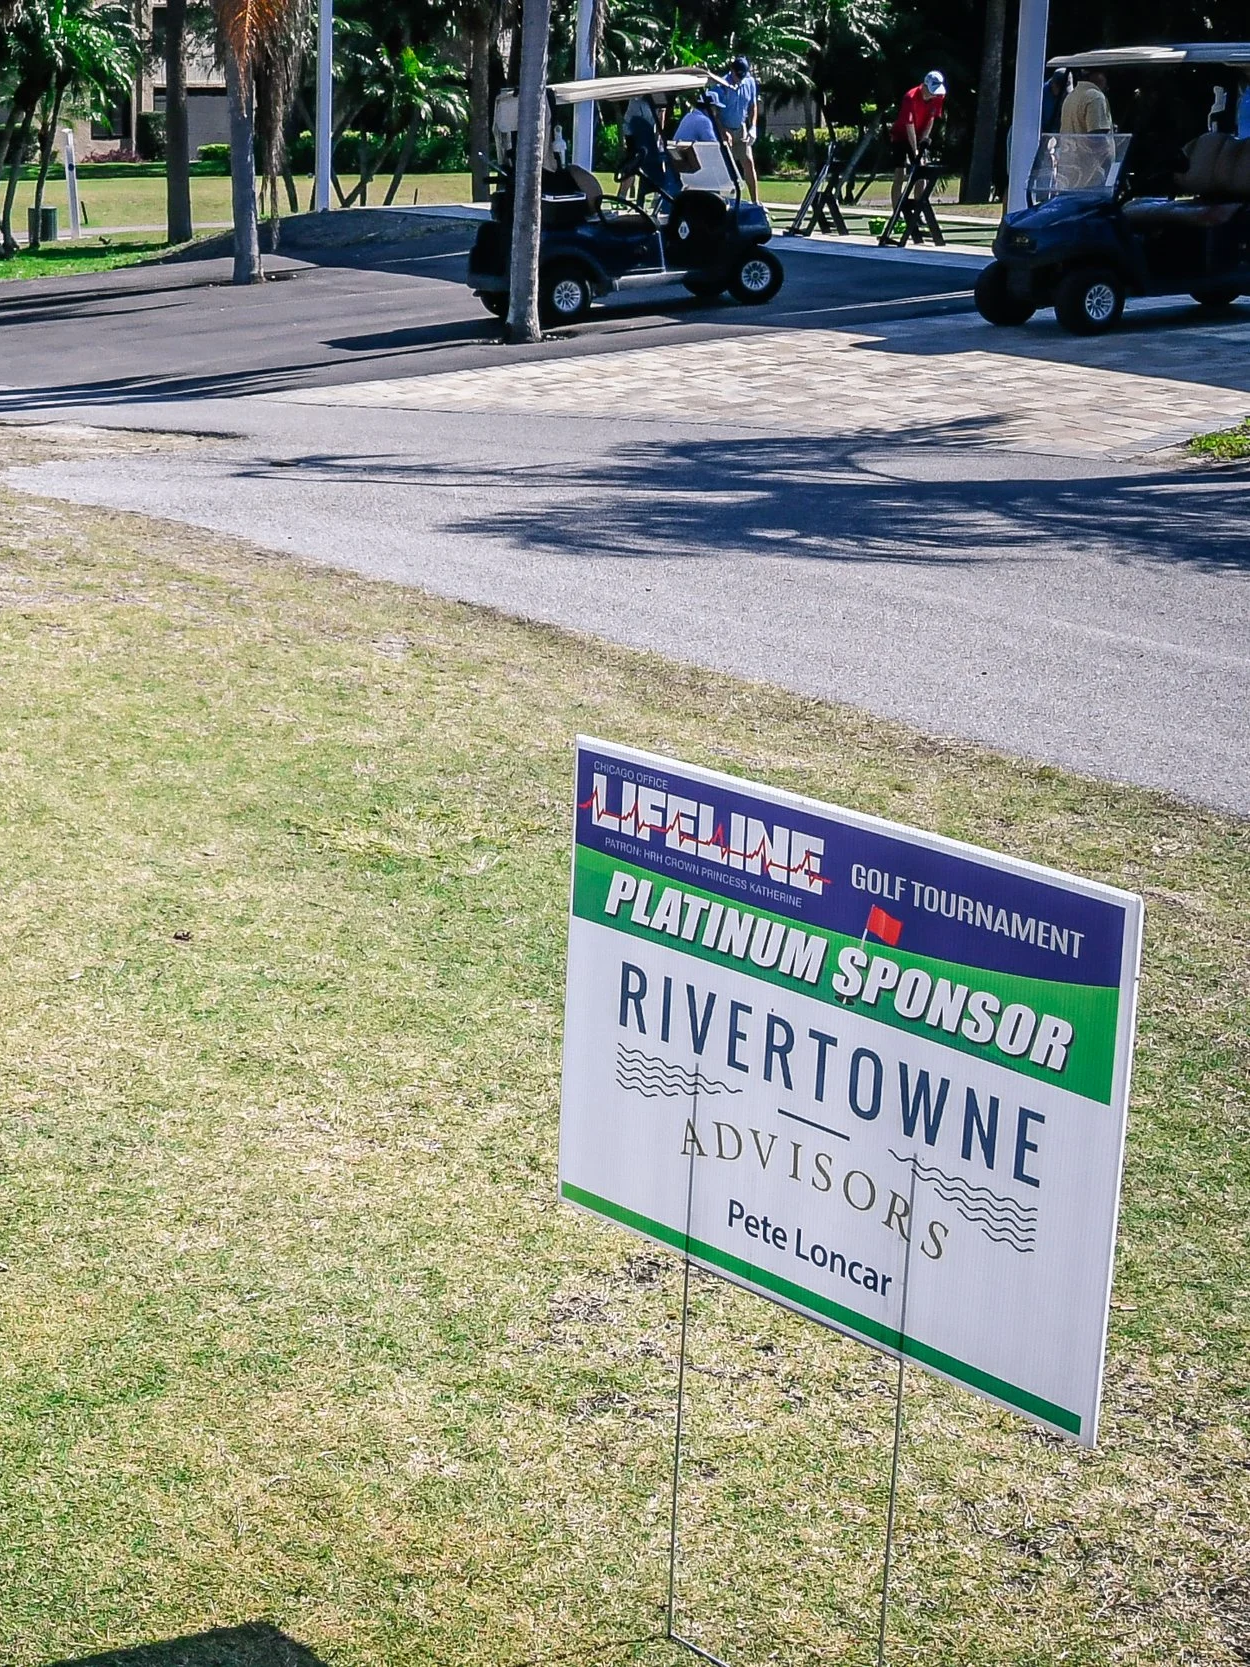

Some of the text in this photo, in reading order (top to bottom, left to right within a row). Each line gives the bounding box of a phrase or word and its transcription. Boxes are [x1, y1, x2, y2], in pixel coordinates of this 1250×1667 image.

[593, 760, 669, 790] CHICAGO OFFICE
[592, 773, 824, 896] LIFELINE
[605, 837, 802, 909] PATRON: HRH CROWN PRINCESS KATHERINE
[851, 864, 1085, 959] GOLF TOURNAMENT
[603, 870, 1075, 1072] PLATINUM SPONSOR
[619, 960, 1045, 1189] RIVERTOWNE
[680, 1118, 949, 1260] ADVISORS
[728, 1199, 892, 1297] Pete Loncar
